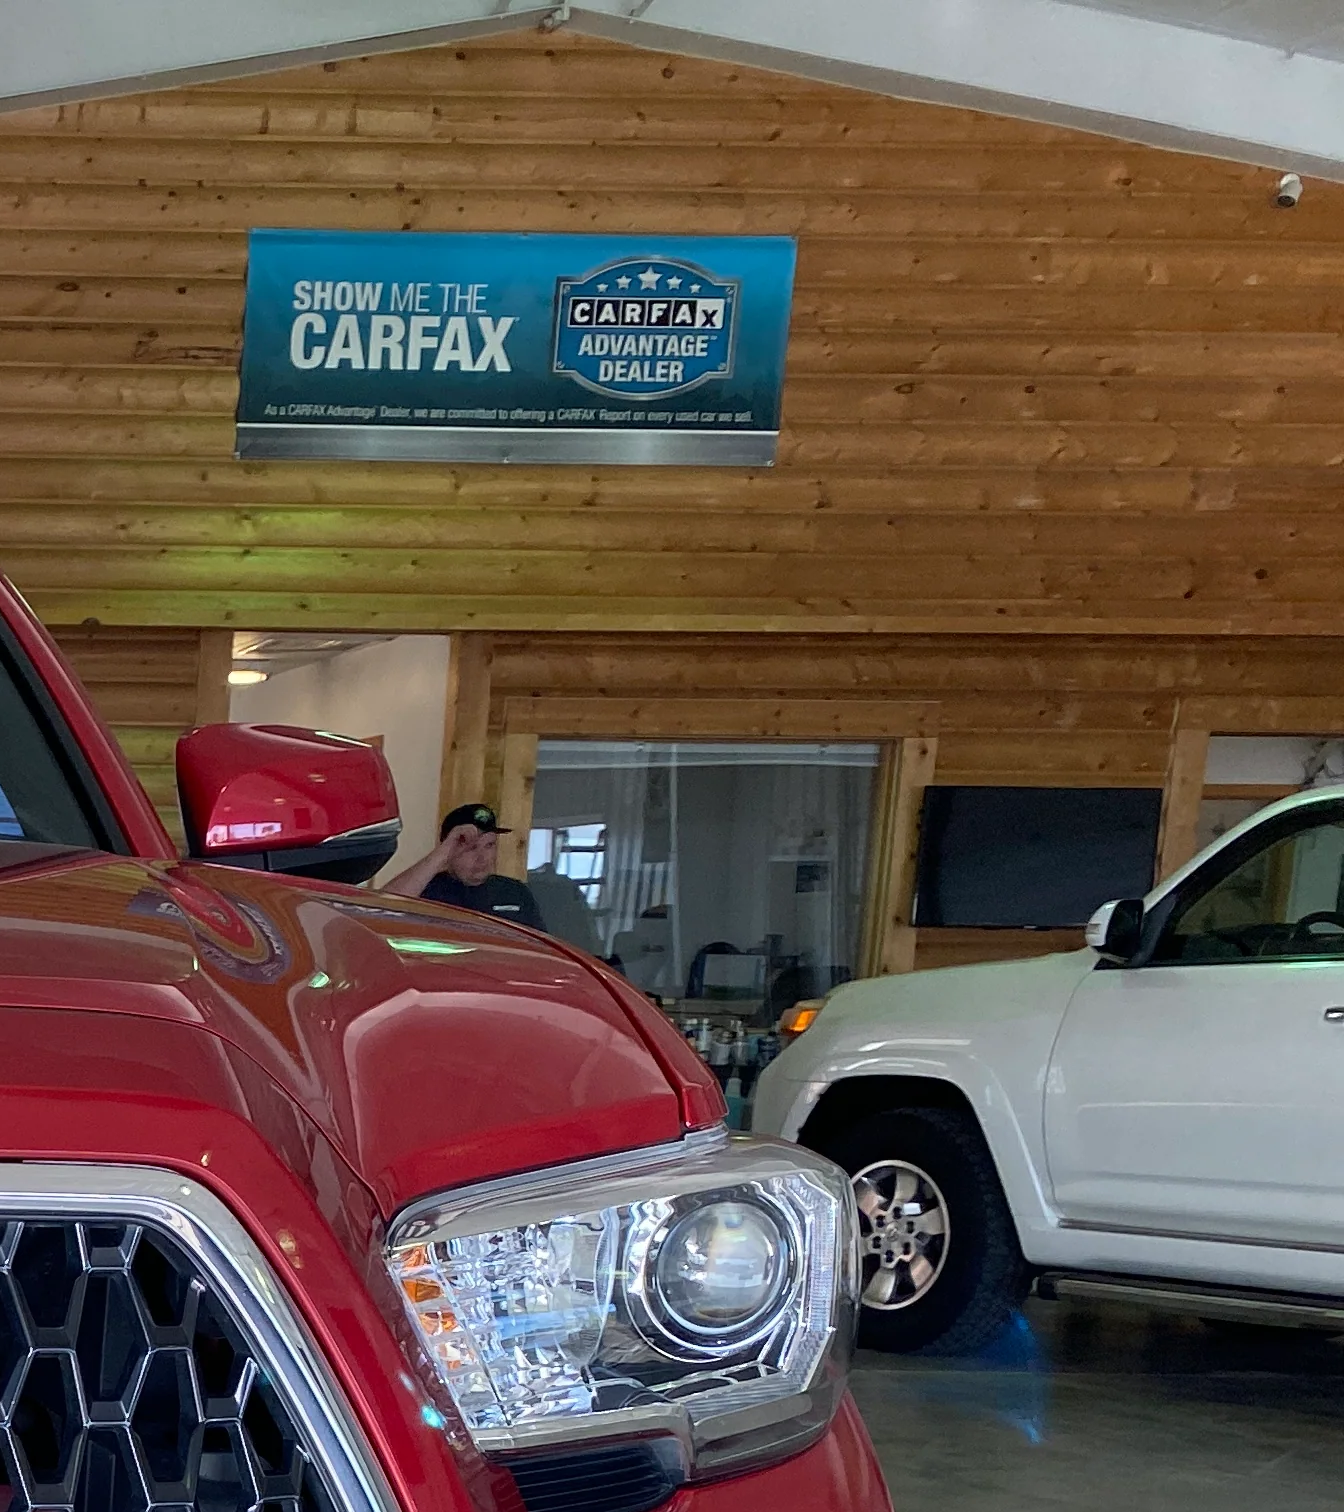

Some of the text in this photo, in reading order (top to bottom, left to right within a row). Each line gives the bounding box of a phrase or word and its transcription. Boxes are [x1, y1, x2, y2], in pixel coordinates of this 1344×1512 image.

[292, 280, 489, 314] SHOW ME THE
[573, 302, 718, 327] CARFAX
[290, 313, 515, 372] CARFAX
[578, 334, 710, 357] ADVANTAGE
[598, 360, 685, 382] DEALER
[498, 408, 508, 420] to
